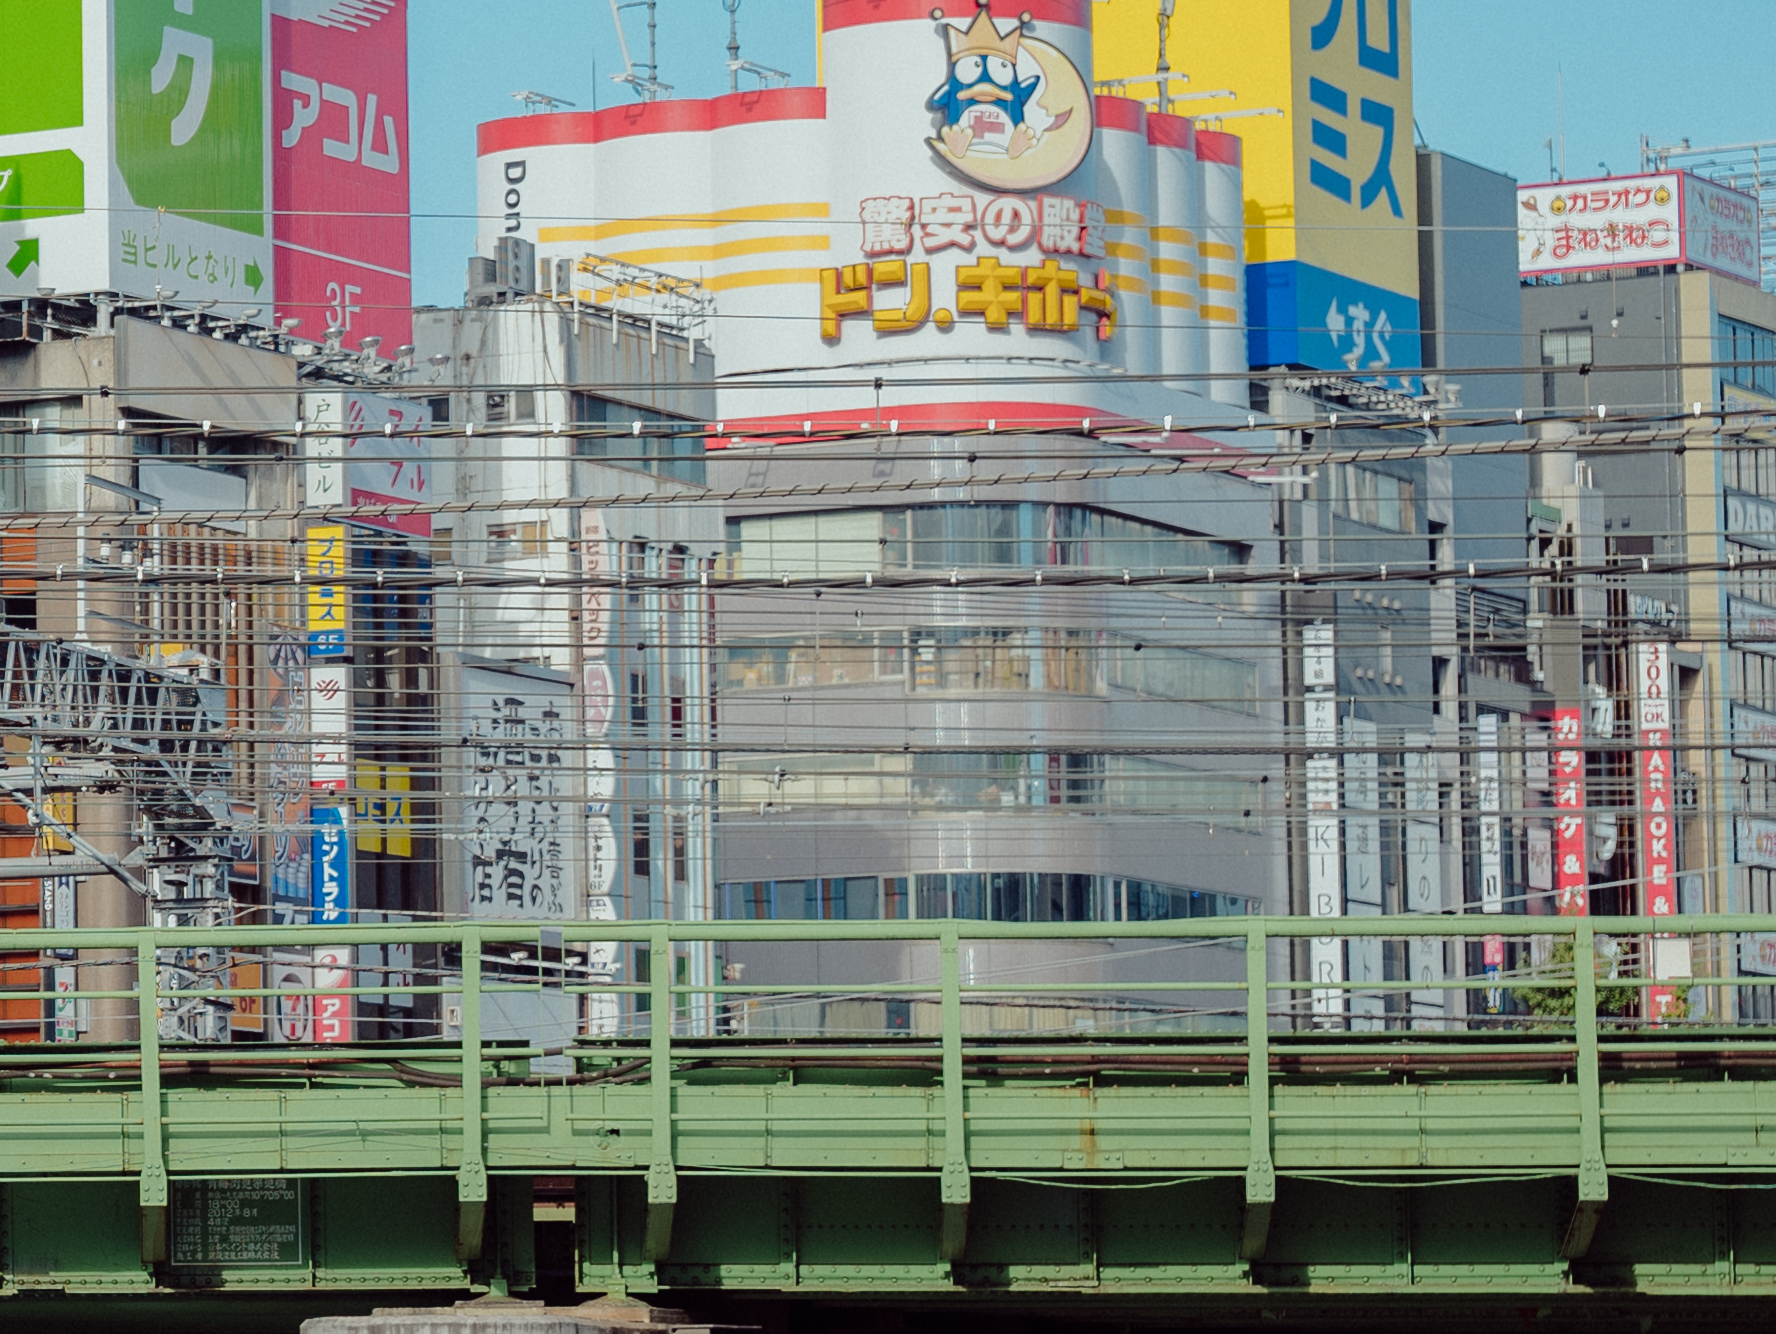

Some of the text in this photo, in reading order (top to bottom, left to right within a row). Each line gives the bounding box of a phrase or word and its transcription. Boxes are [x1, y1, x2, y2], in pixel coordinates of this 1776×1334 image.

[280, 68, 400, 174] アコム
[1568, 187, 1654, 216] カラオケ
[1714, 197, 1747, 221] カラオケ
[859, 192, 1106, 258] 驚安の殿堂
[1551, 218, 1672, 261] まねきねこ
[120, 229, 238, 290] 当ビルとなり
[325, 281, 361, 331] 3F
[322, 998, 340, 1041] アコ
